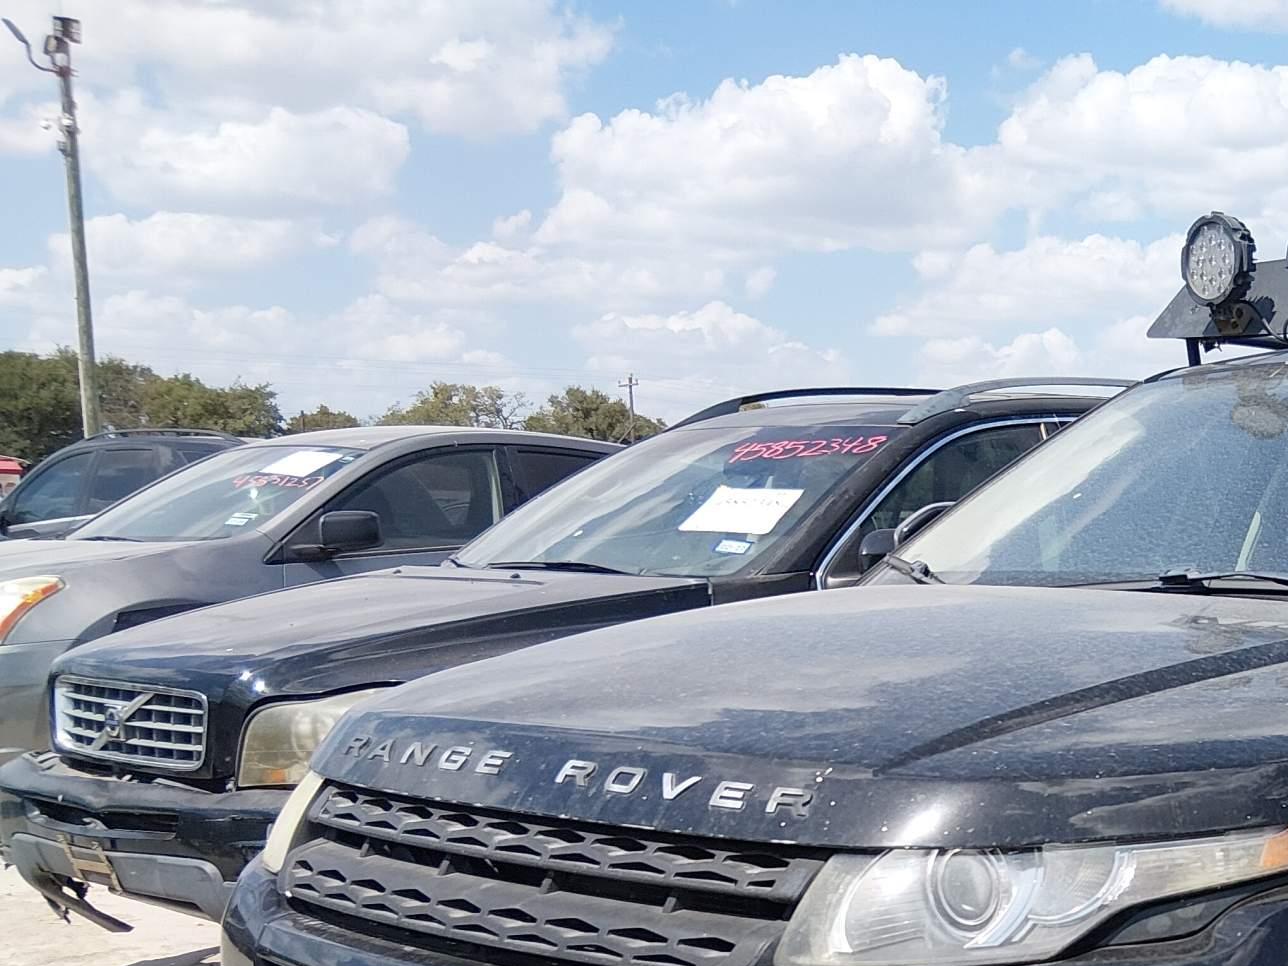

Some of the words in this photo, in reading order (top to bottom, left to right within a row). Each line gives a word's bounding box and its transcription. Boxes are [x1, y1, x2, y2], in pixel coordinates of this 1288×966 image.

[728, 436, 888, 464] 45852348
[343, 735, 512, 775] RANGE
[555, 759, 815, 817] ROVER
